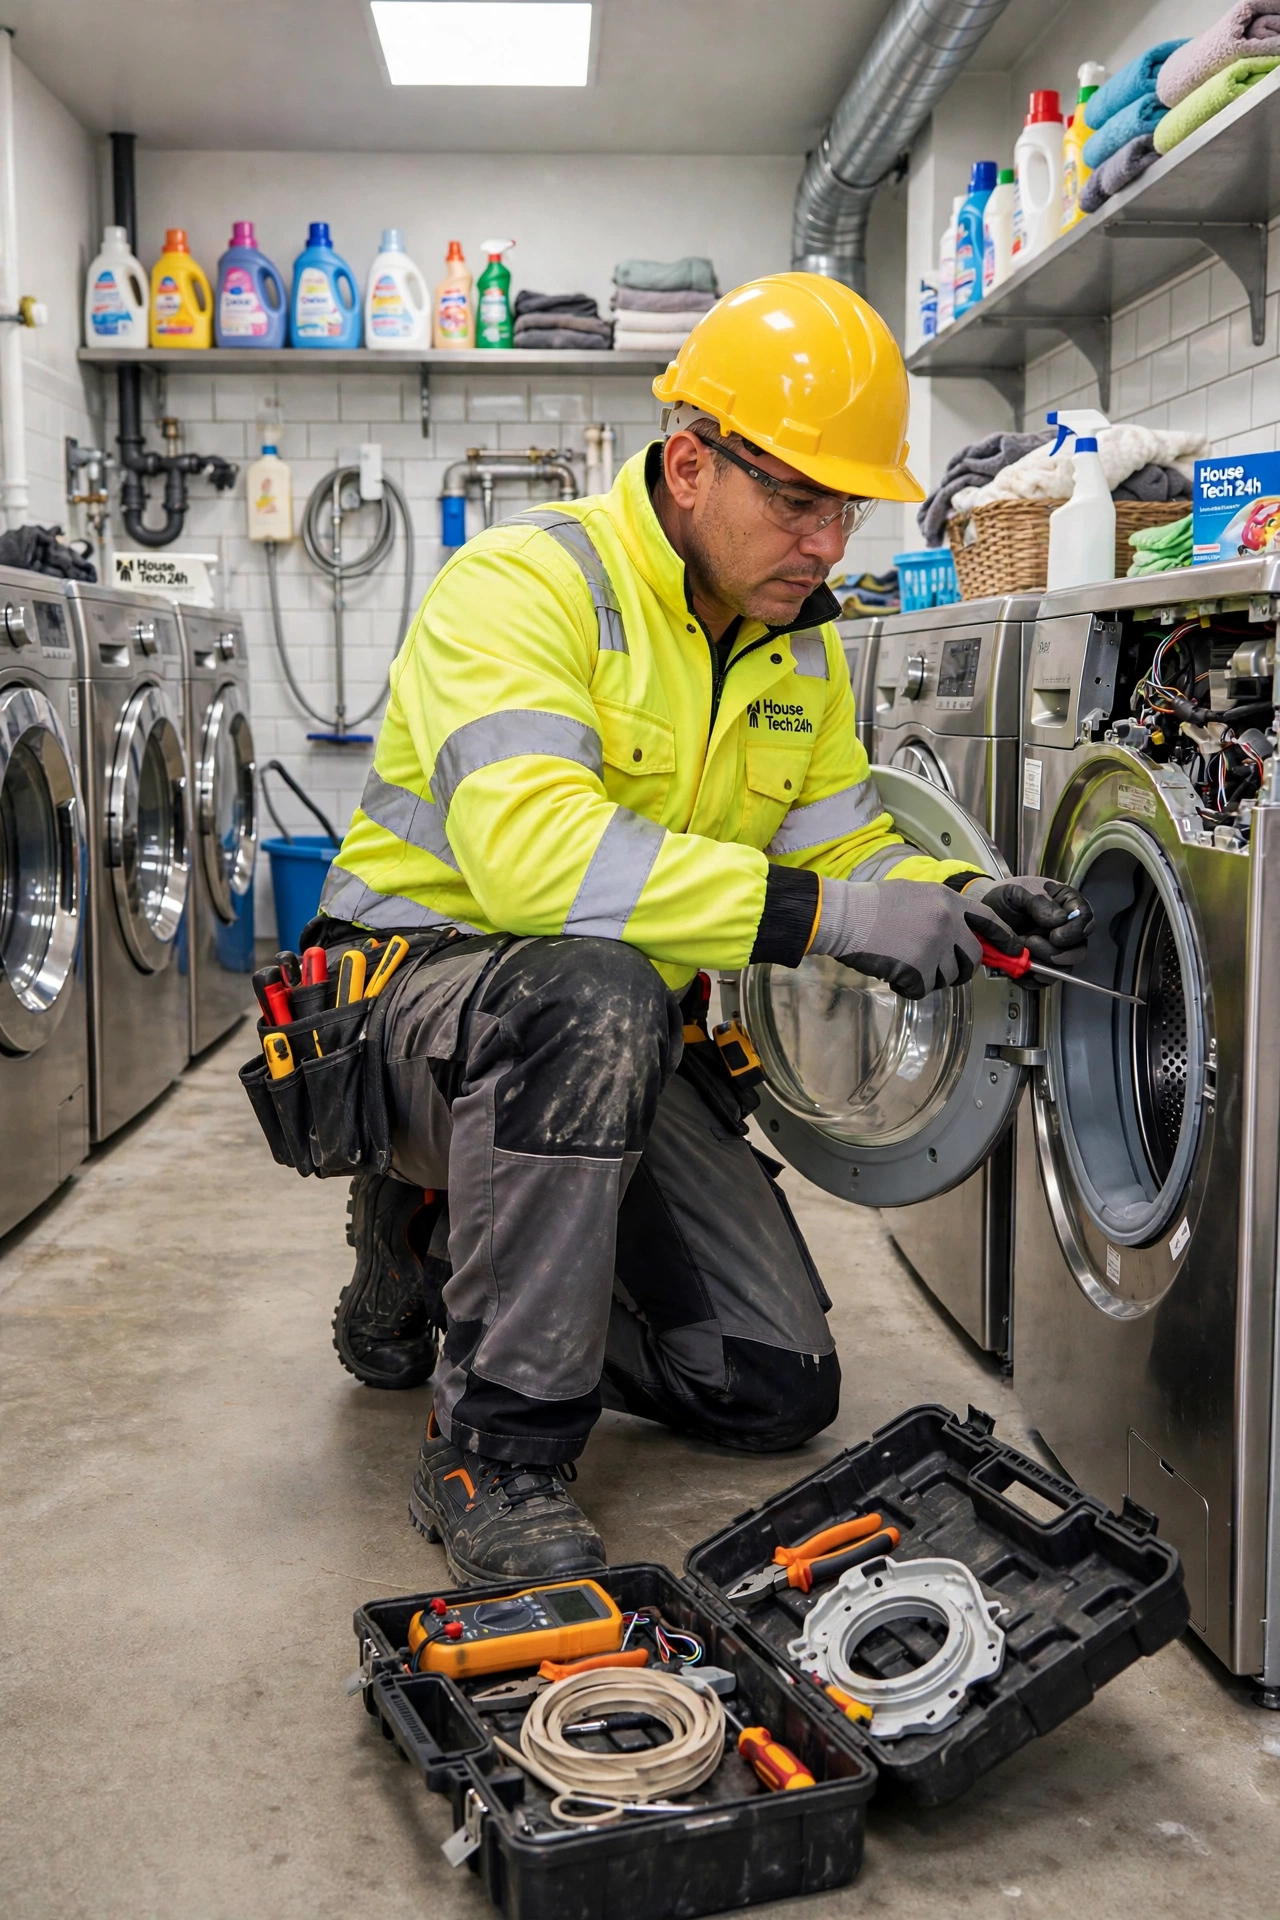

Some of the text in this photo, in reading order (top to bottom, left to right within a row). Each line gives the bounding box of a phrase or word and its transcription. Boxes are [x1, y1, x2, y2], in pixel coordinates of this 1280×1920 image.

[1200, 466, 1244, 482] House
[1200, 477, 1261, 498] Tech 24h
[137, 559, 175, 571] House
[139, 571, 188, 584] Tech 24h
[763, 699, 803, 715] House
[765, 715, 812, 733] Tech 24h
